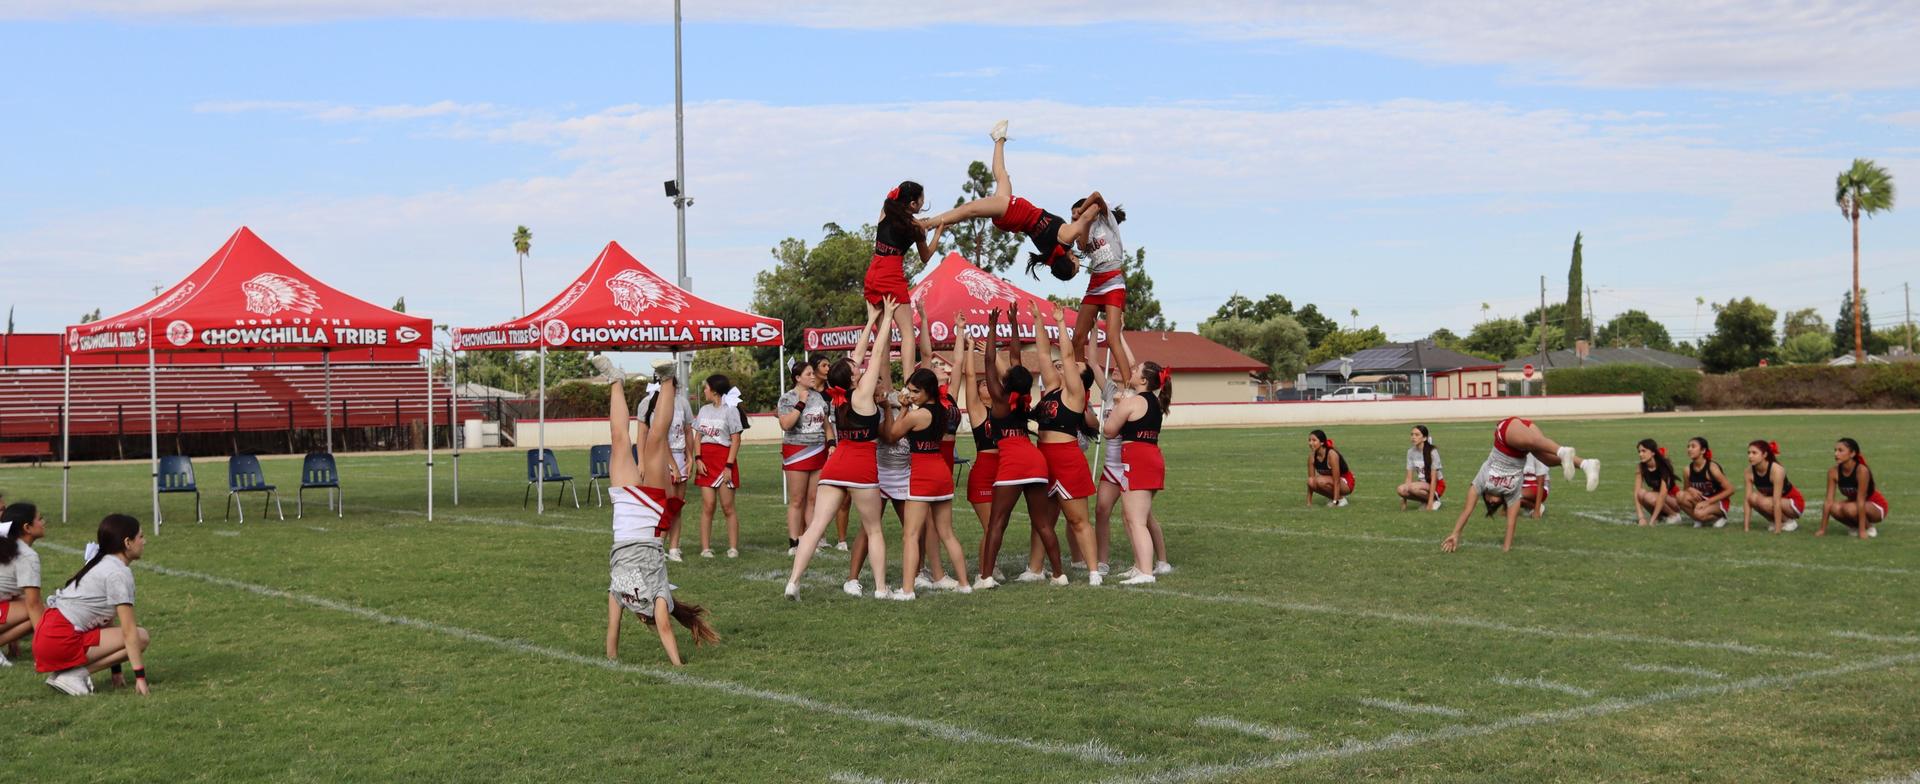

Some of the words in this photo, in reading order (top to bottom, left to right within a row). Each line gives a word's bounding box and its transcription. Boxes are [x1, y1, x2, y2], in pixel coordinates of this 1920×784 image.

[200, 327, 328, 345] CHOWCHILLA
[334, 328, 388, 344] TRIBE
[462, 331, 506, 346] CHOWCHILLA
[508, 330, 528, 344] TRIBE
[571, 326, 694, 342] CHOWCHILLA
[700, 327, 750, 342] TRIBE
